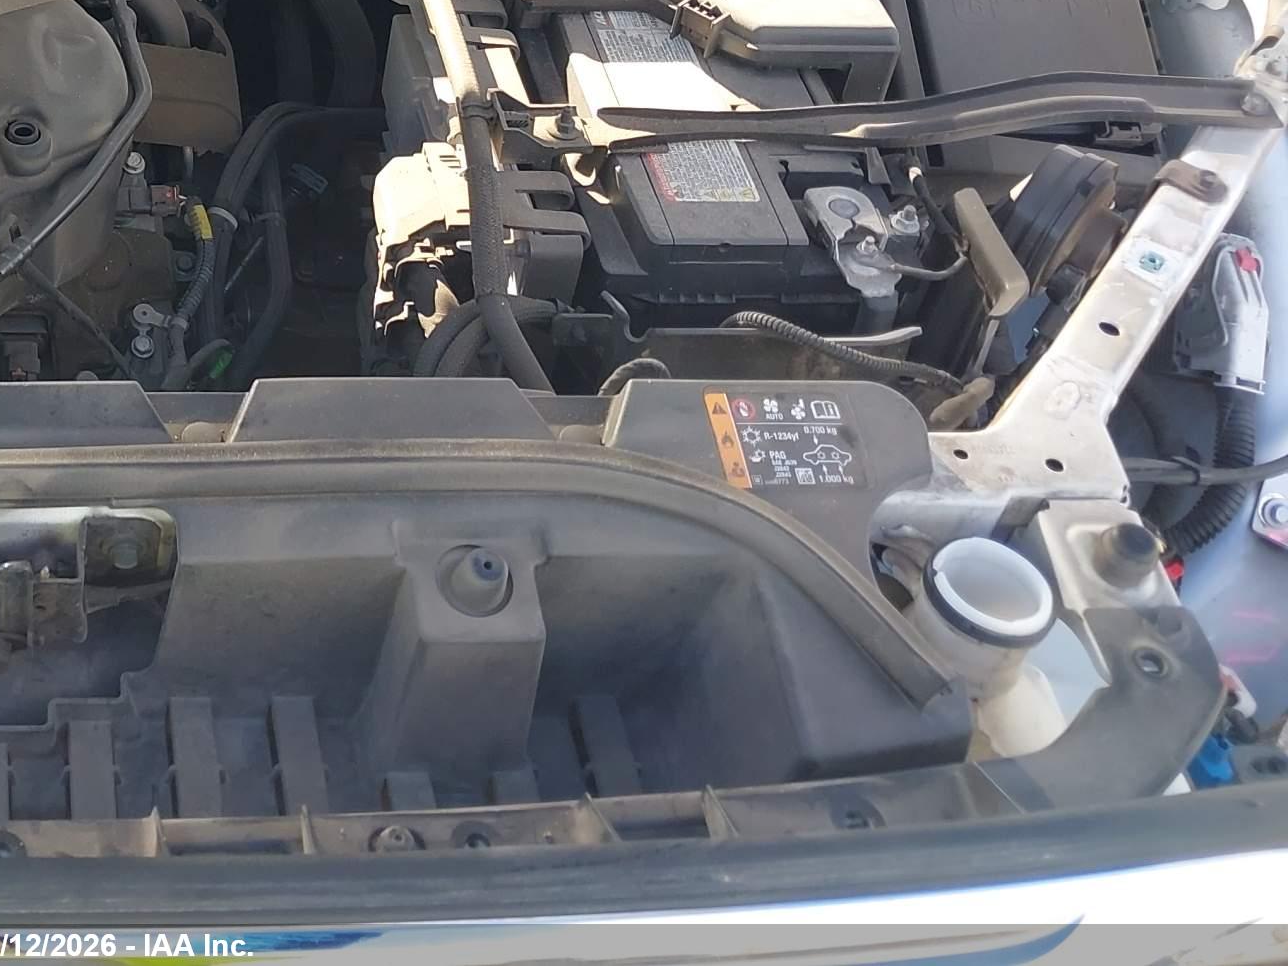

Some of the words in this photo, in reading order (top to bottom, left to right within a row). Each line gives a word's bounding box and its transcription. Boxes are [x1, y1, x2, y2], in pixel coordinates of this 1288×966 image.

[804, 426, 825, 434] 0.700
[826, 425, 838, 436] kg
[763, 432, 799, 442] R-1234yf
[769, 450, 786, 459] PAG
[819, 474, 842, 483] 1.000
[842, 474, 855, 485] kg
